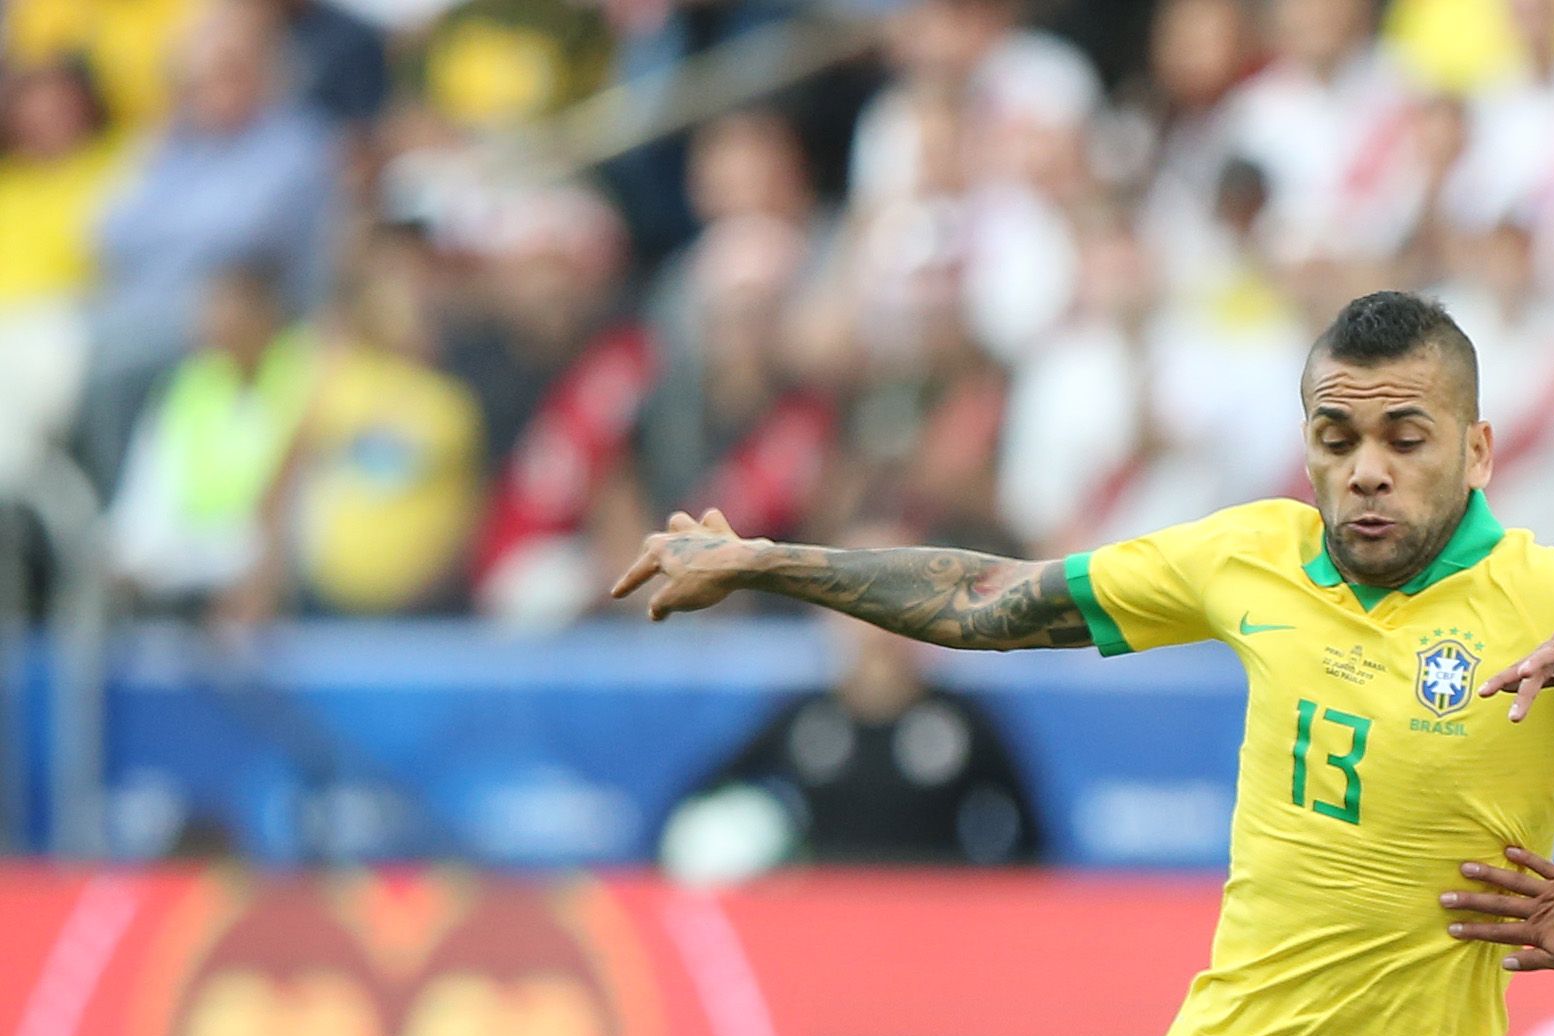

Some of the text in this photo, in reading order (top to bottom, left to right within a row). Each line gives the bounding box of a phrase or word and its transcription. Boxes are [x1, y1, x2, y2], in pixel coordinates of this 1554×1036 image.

[1435, 671, 1457, 681] CBF
[1409, 718, 1468, 736] BRASIL
[1292, 697, 1372, 825] 13
